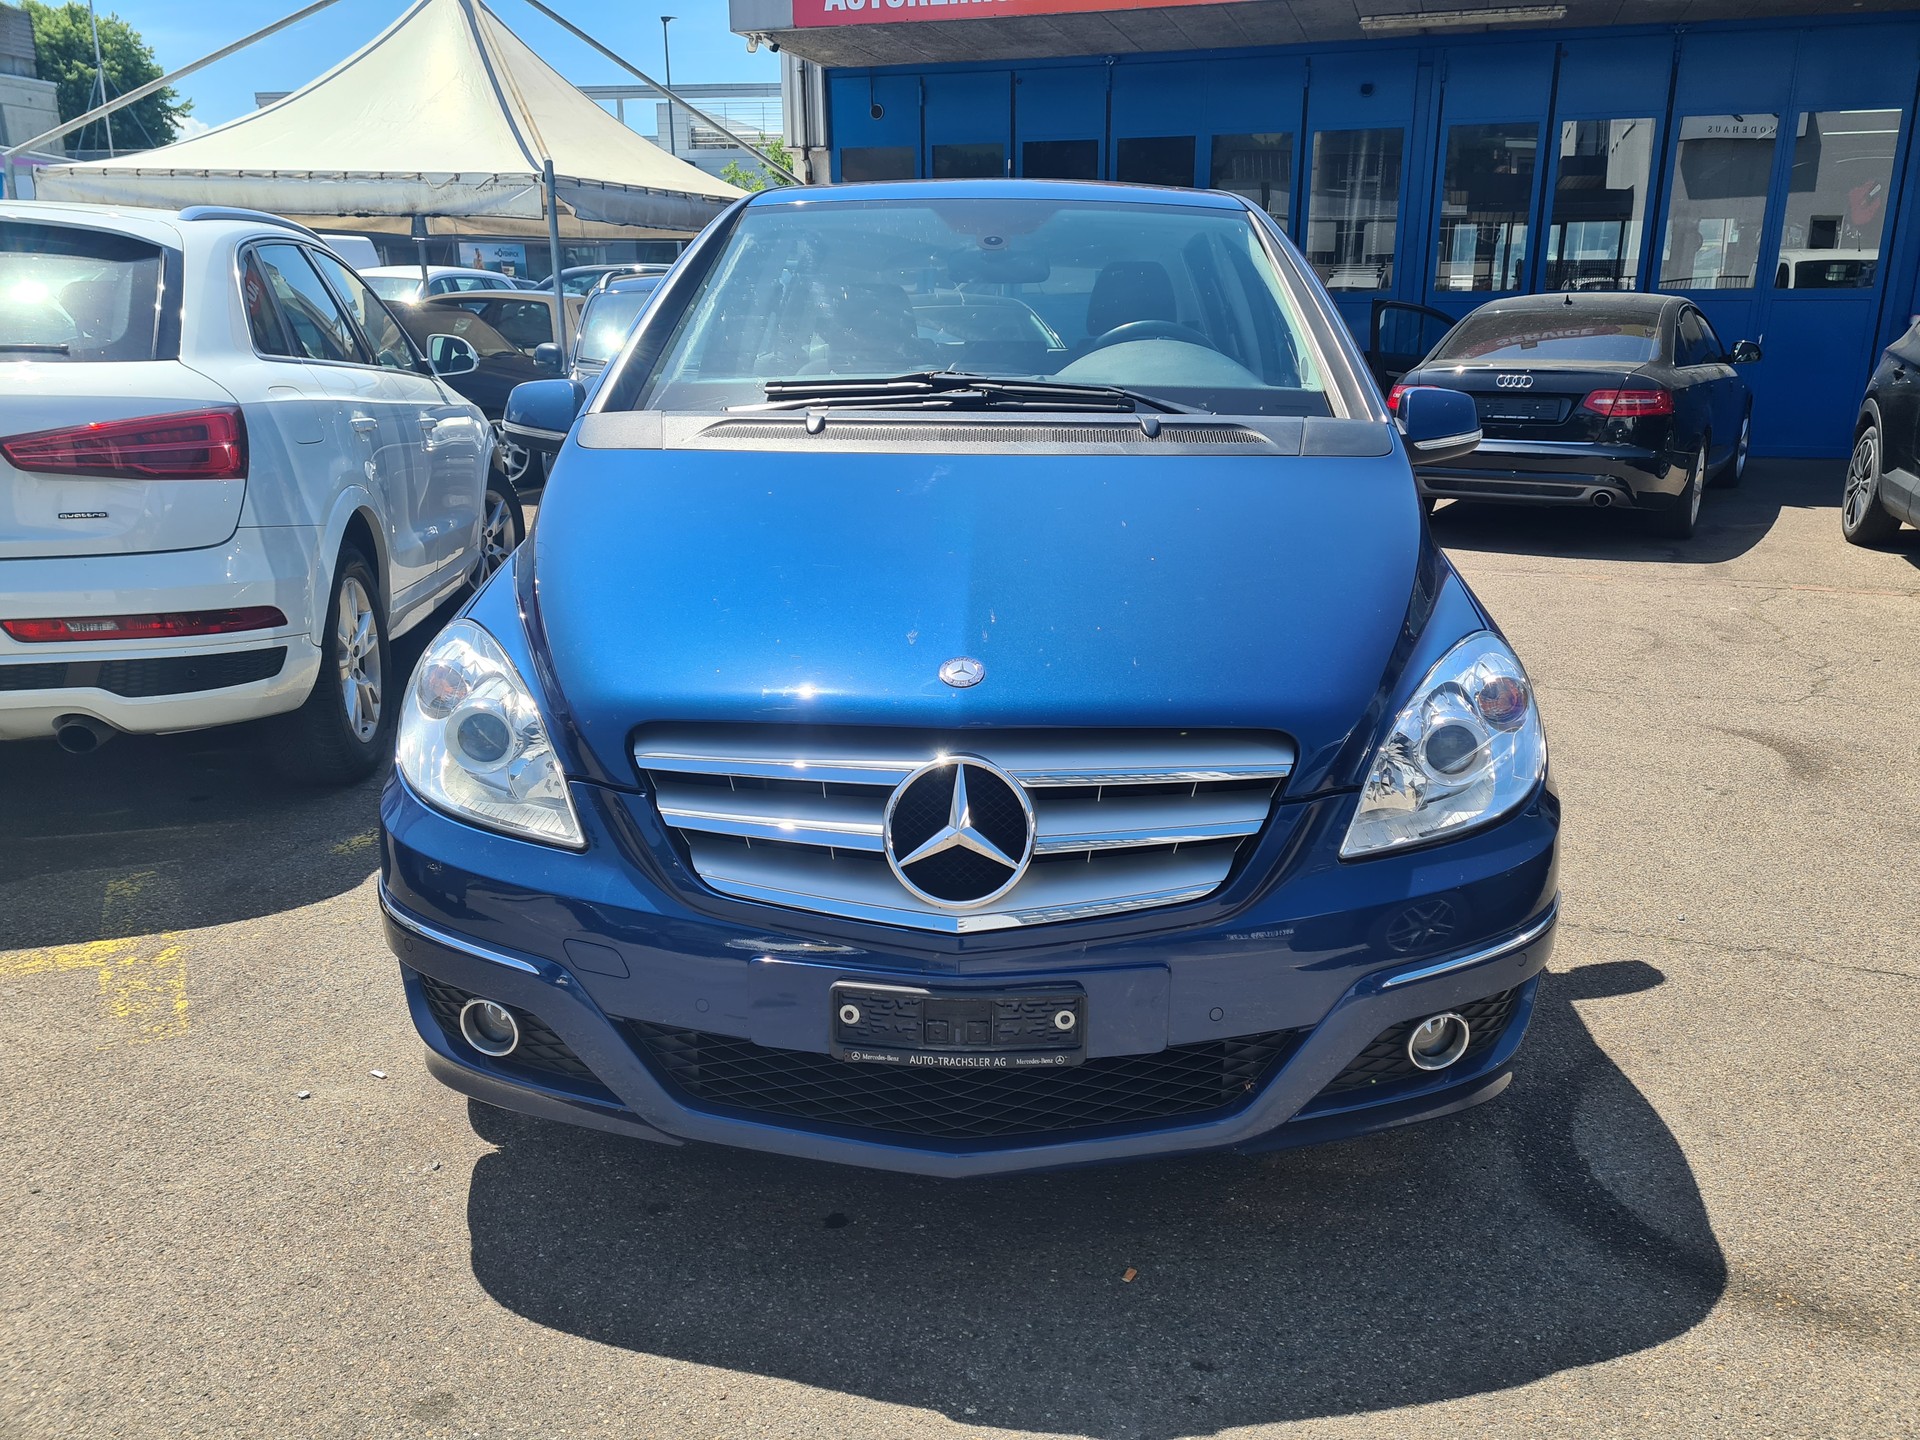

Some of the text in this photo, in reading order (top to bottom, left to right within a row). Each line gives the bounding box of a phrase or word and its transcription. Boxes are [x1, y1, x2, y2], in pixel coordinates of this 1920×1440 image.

[862, 1052, 1054, 1067] Mercedes-Benz AUTO-TRACHSLER AG Mercedes-Benz
